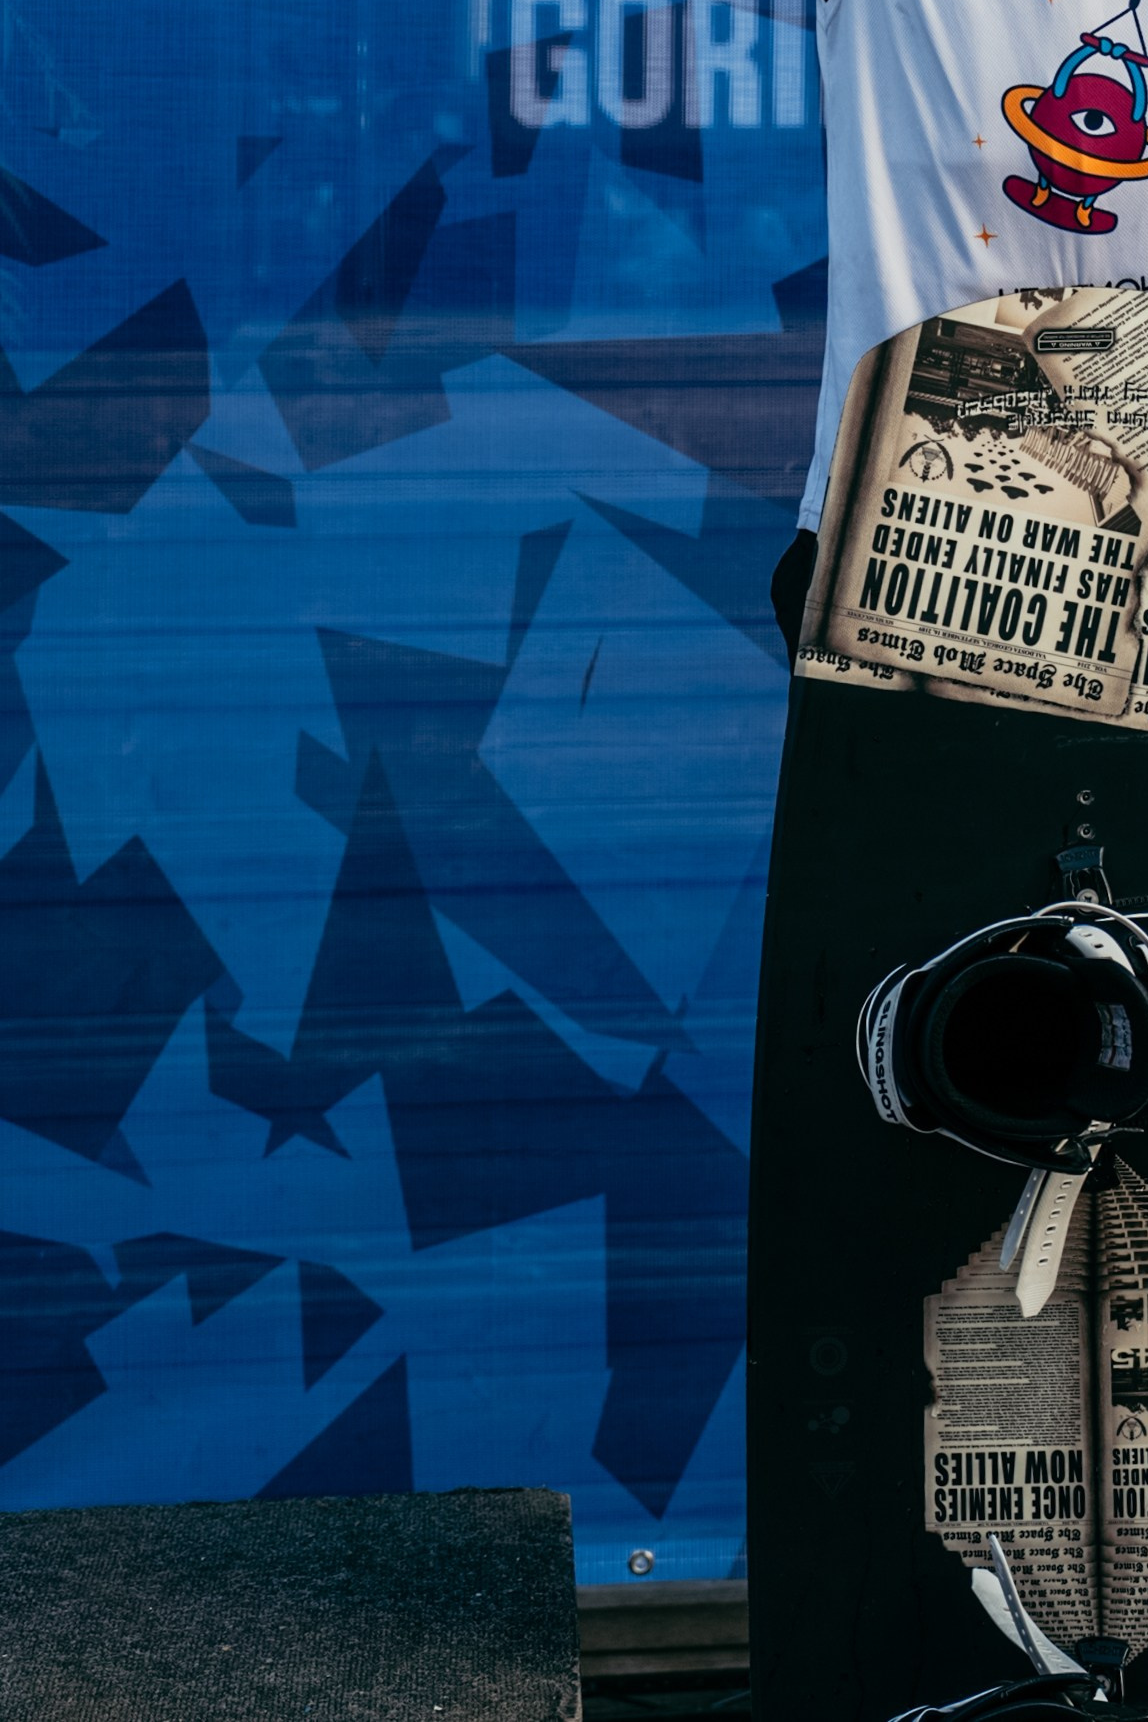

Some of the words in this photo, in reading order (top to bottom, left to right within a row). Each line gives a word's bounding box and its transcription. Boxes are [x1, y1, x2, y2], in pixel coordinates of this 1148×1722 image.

[880, 487, 972, 533] ALIENS
[977, 509, 1013, 543] ON
[871, 523, 957, 568] ENDED
[1022, 518, 1080, 558] WAR
[1088, 533, 1135, 572] THE
[963, 544, 1069, 593] FINALLY
[858, 556, 1047, 646] COALITION
[1076, 568, 1133, 607] HAS
[856, 627, 925, 661] Times
[1054, 600, 1120, 663] THE
[933, 644, 986, 675] Mob
[992, 657, 1056, 689] Space
[1062, 672, 1103, 701] The
[875, 1000, 898, 1122] SLINGSHOT
[933, 1450, 1016, 1486] ALLIES
[1023, 1448, 1082, 1484] NOW
[933, 1485, 1024, 1522] ENEMIES
[1030, 1484, 1085, 1520] ONCE
[942, 1527, 981, 1544] Times
[1018, 1526, 1054, 1542] Space
[1057, 1525, 1081, 1542] The
[1114, 1544, 1148, 1557] Times
[1003, 1547, 1025, 1559] Mo
[1062, 1546, 1083, 1558] The
[1112, 1561, 1143, 1573] Times
